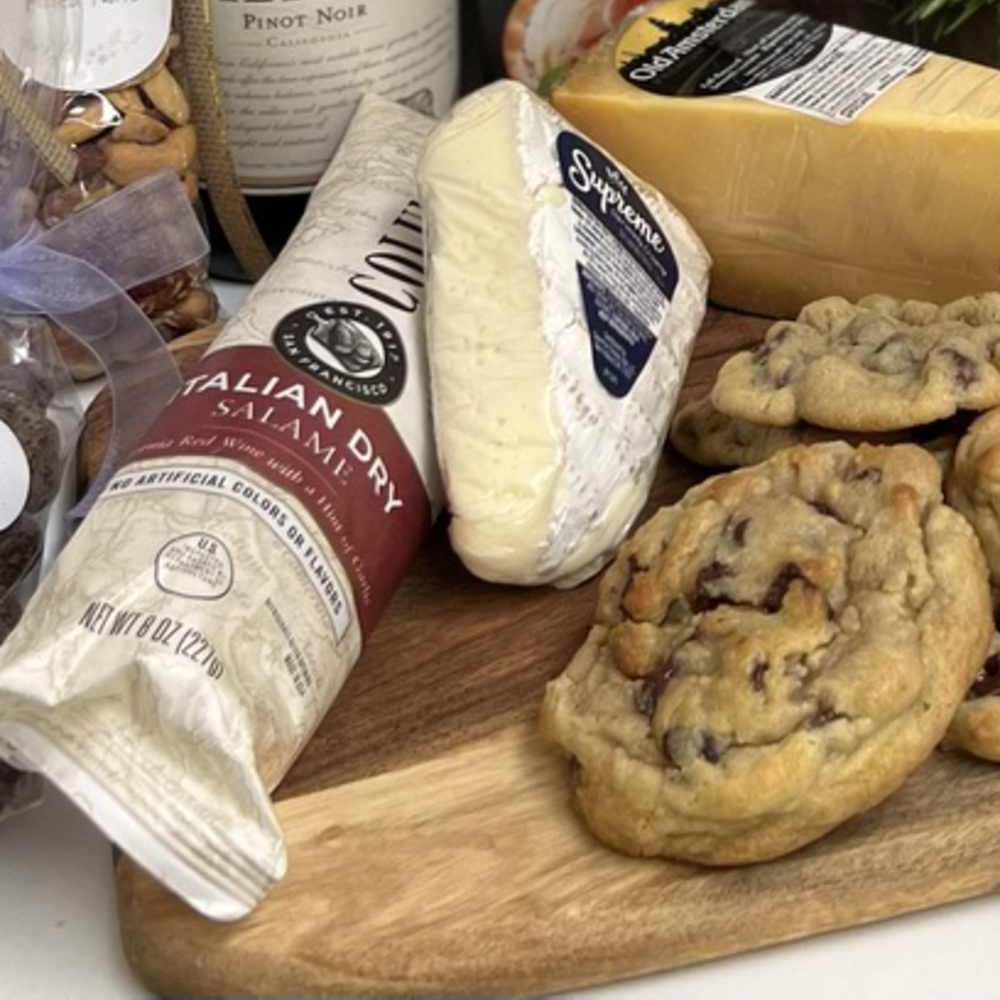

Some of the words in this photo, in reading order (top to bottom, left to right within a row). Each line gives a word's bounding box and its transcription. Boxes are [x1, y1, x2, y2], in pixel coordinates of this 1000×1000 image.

[243, 12, 308, 31] PINOT
[317, 3, 368, 26] NOIR
[629, 53, 673, 83] Old
[567, 149, 666, 254] Supreme
[298, 357, 388, 397] FRANCISCO
[182, 371, 343, 430] TALIAN
[347, 428, 404, 515] DRY
[135, 470, 227, 490] ARTIFICIAL
[231, 481, 287, 527] COLORS
[286, 525, 305, 548] OR
[304, 547, 343, 615] FLAVORS
[78, 601, 115, 633] NET
[154, 616, 180, 646] OZ
